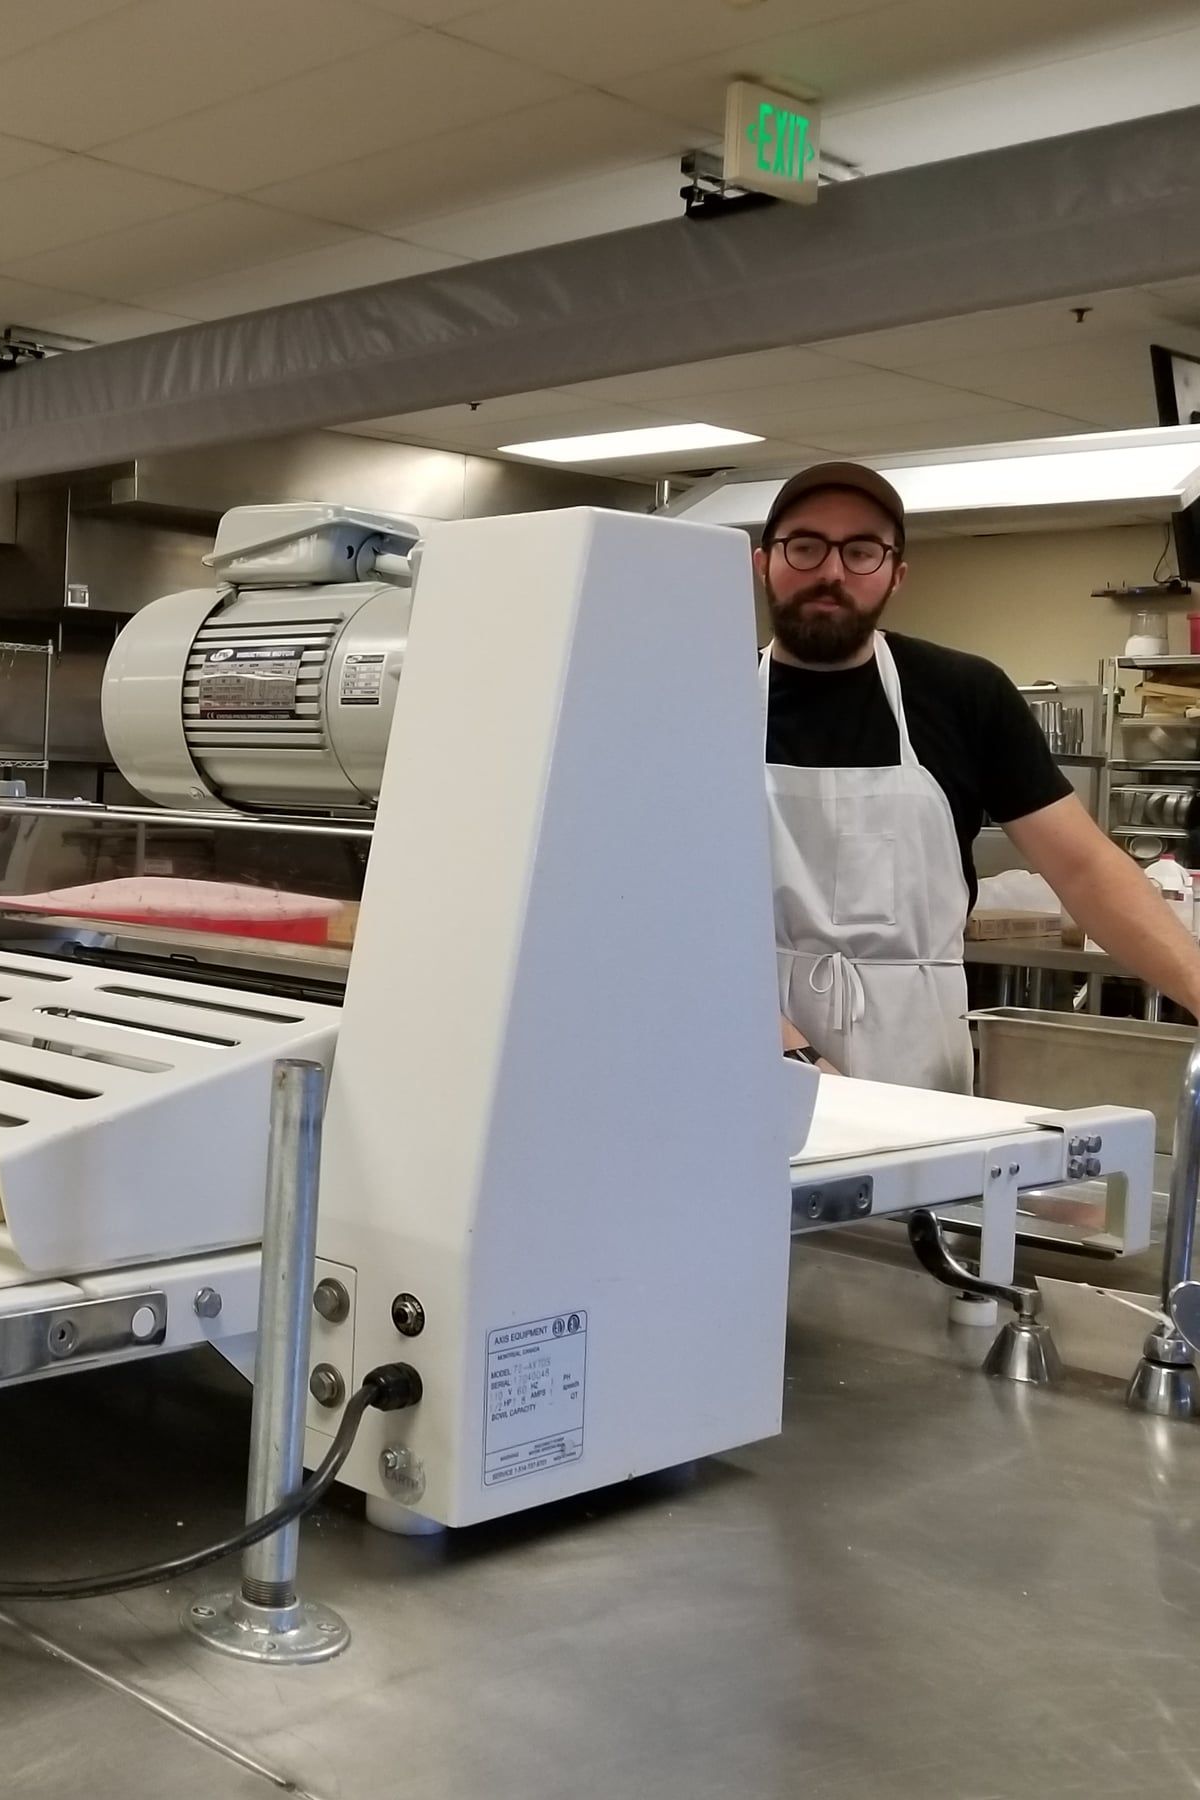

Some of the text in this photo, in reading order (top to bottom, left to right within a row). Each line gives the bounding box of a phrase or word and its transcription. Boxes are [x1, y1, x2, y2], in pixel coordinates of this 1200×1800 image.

[756, 102, 811, 182] EXIT
[494, 1334, 510, 1345] AXIS
[510, 1326, 548, 1342] EQUIPMENT
[491, 1368, 511, 1379] MODEL
[563, 1373, 571, 1381] PH
[491, 1380, 511, 1391] SERIAL
[503, 1398, 513, 1407] HP
[530, 1388, 546, 1399] AMPS
[509, 1404, 536, 1417] CAPACITY
